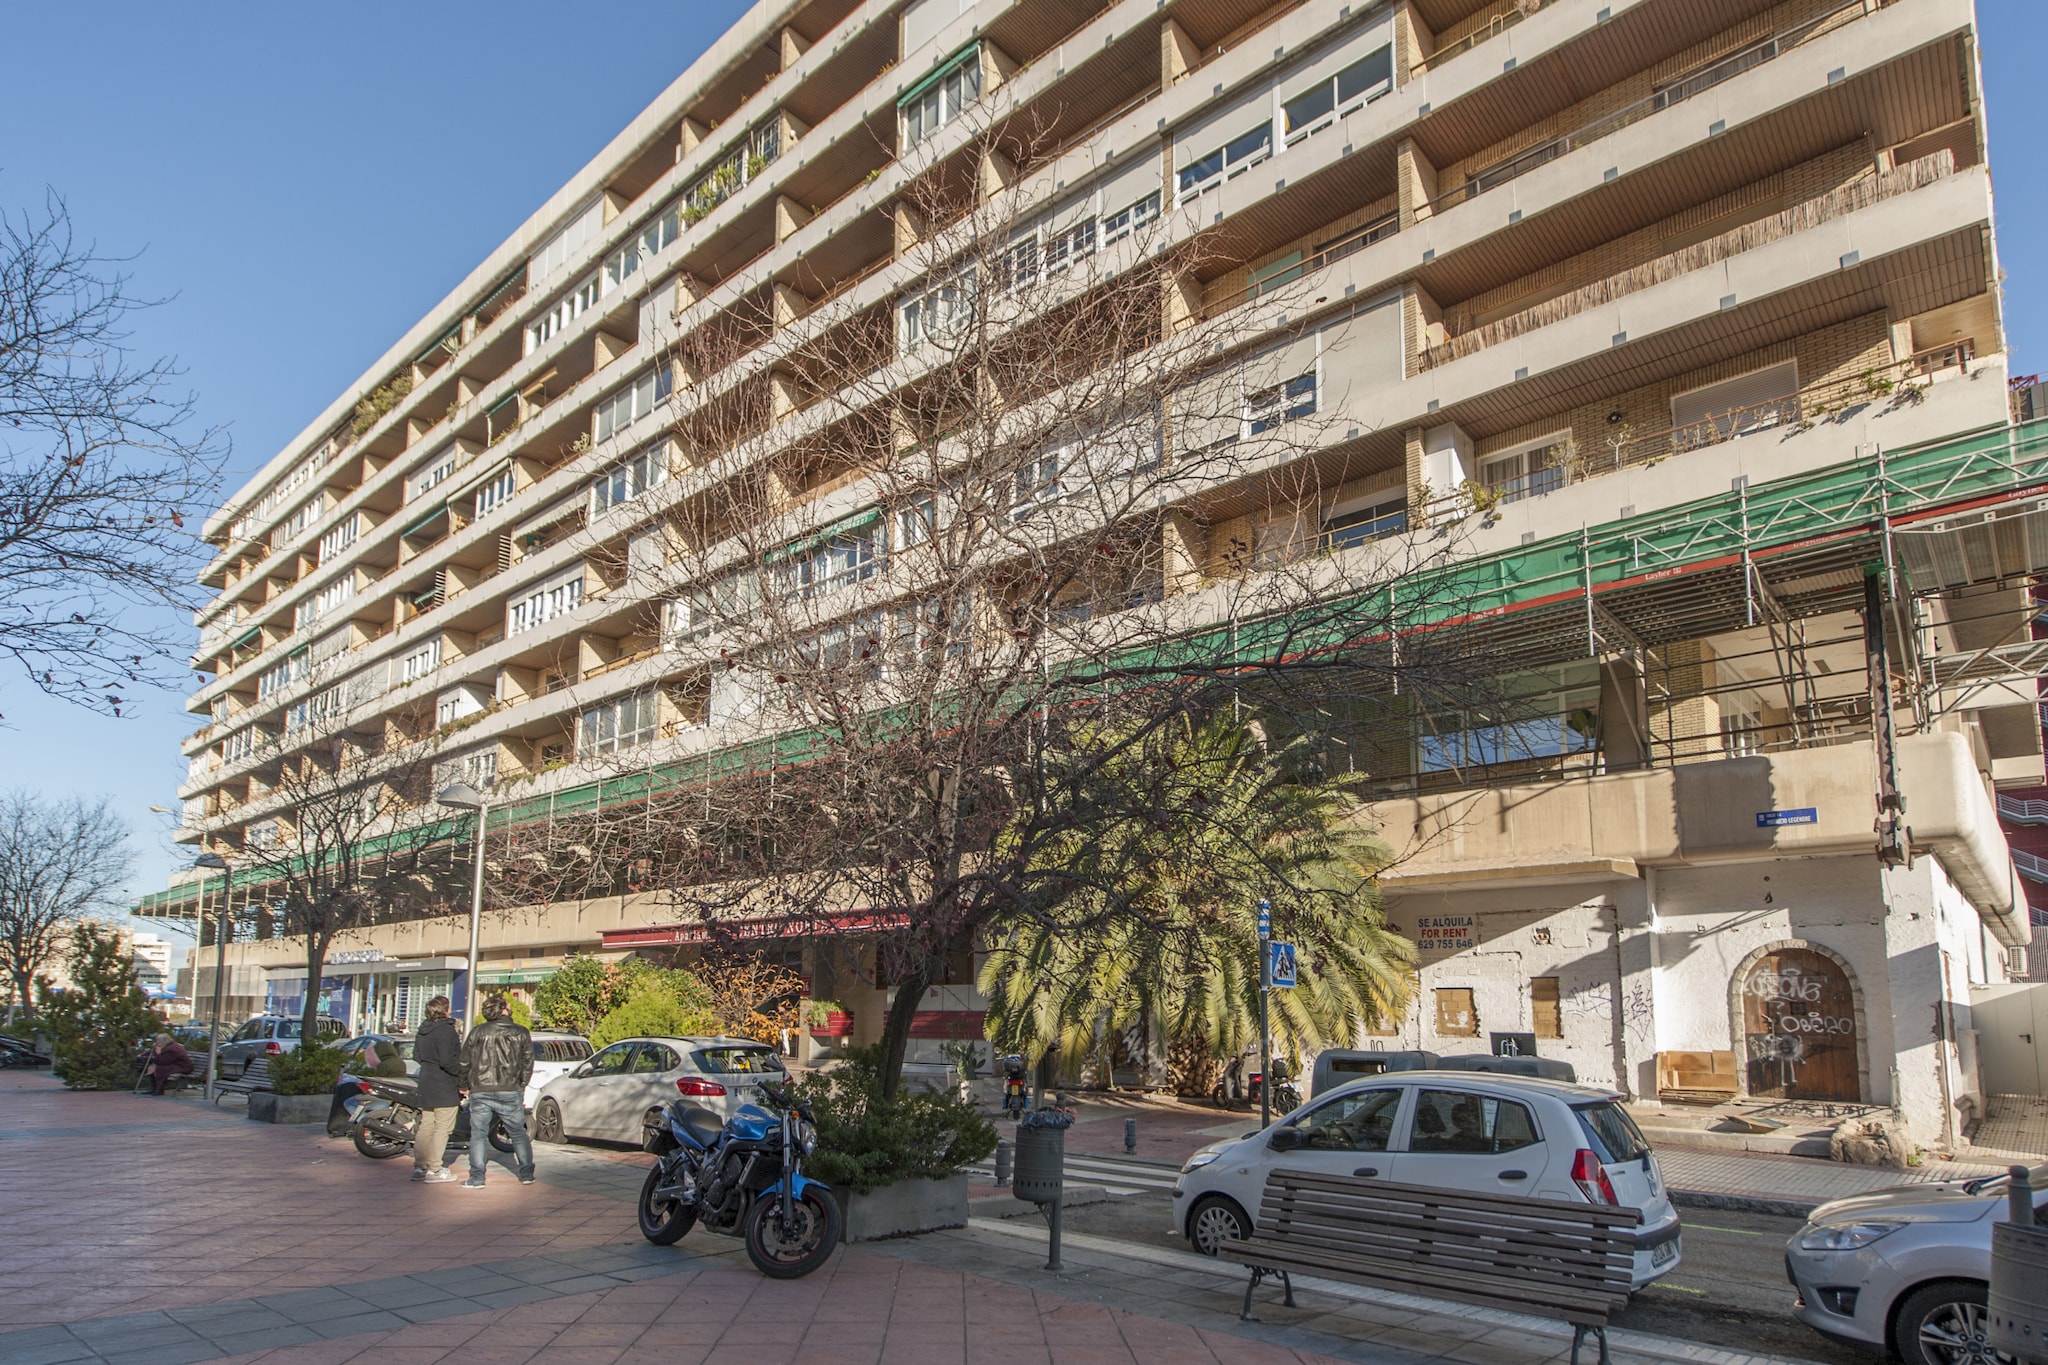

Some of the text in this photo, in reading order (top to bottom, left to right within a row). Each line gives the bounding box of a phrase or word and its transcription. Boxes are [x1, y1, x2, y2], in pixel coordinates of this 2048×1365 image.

[1418, 916, 1473, 928] SE ALQUILA
[1421, 927, 1468, 939] FOR RENT
[1417, 938, 1473, 949] 629 755 646
